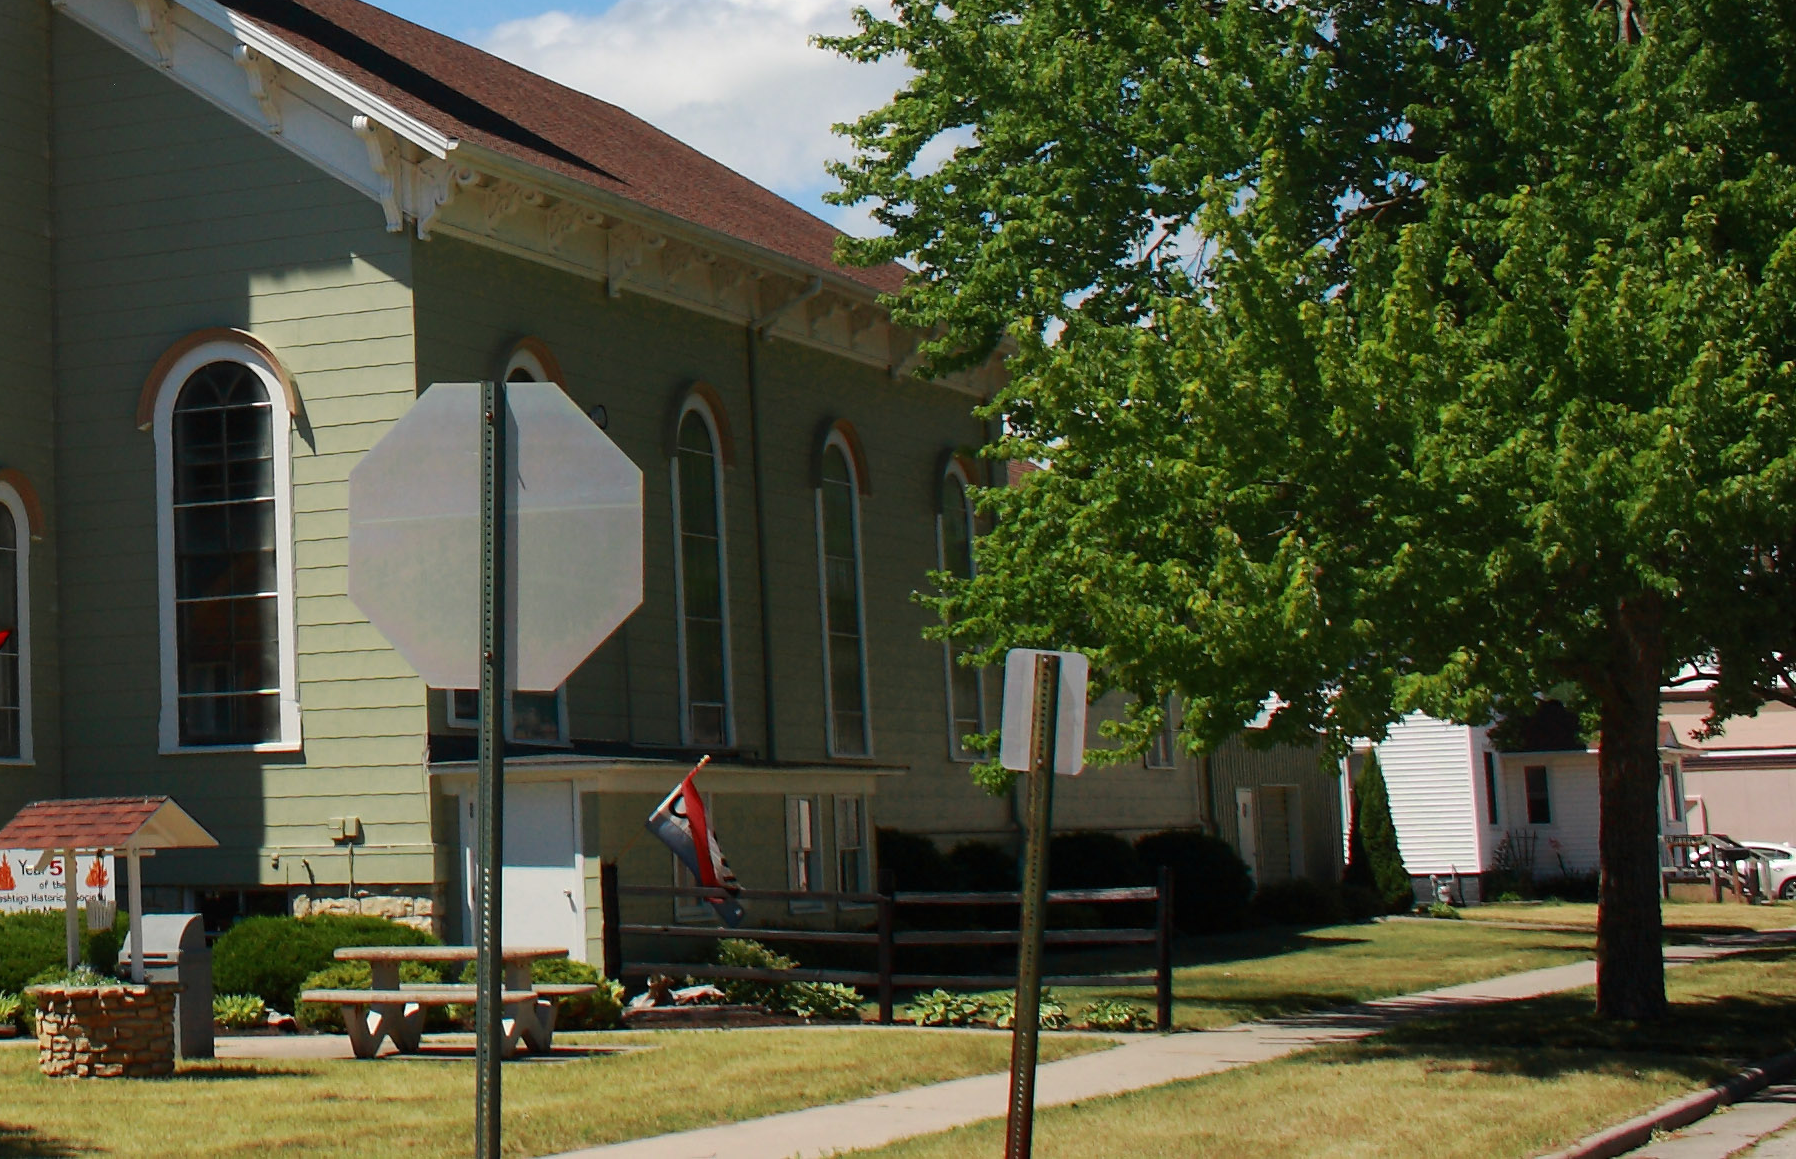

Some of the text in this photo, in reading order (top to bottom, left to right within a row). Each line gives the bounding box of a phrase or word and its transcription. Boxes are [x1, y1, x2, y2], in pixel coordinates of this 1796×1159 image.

[18, 859, 45, 876] Yea
[39, 880, 49, 890] of
[31, 893, 66, 903] Historic
[76, 893, 107, 905] ociey
